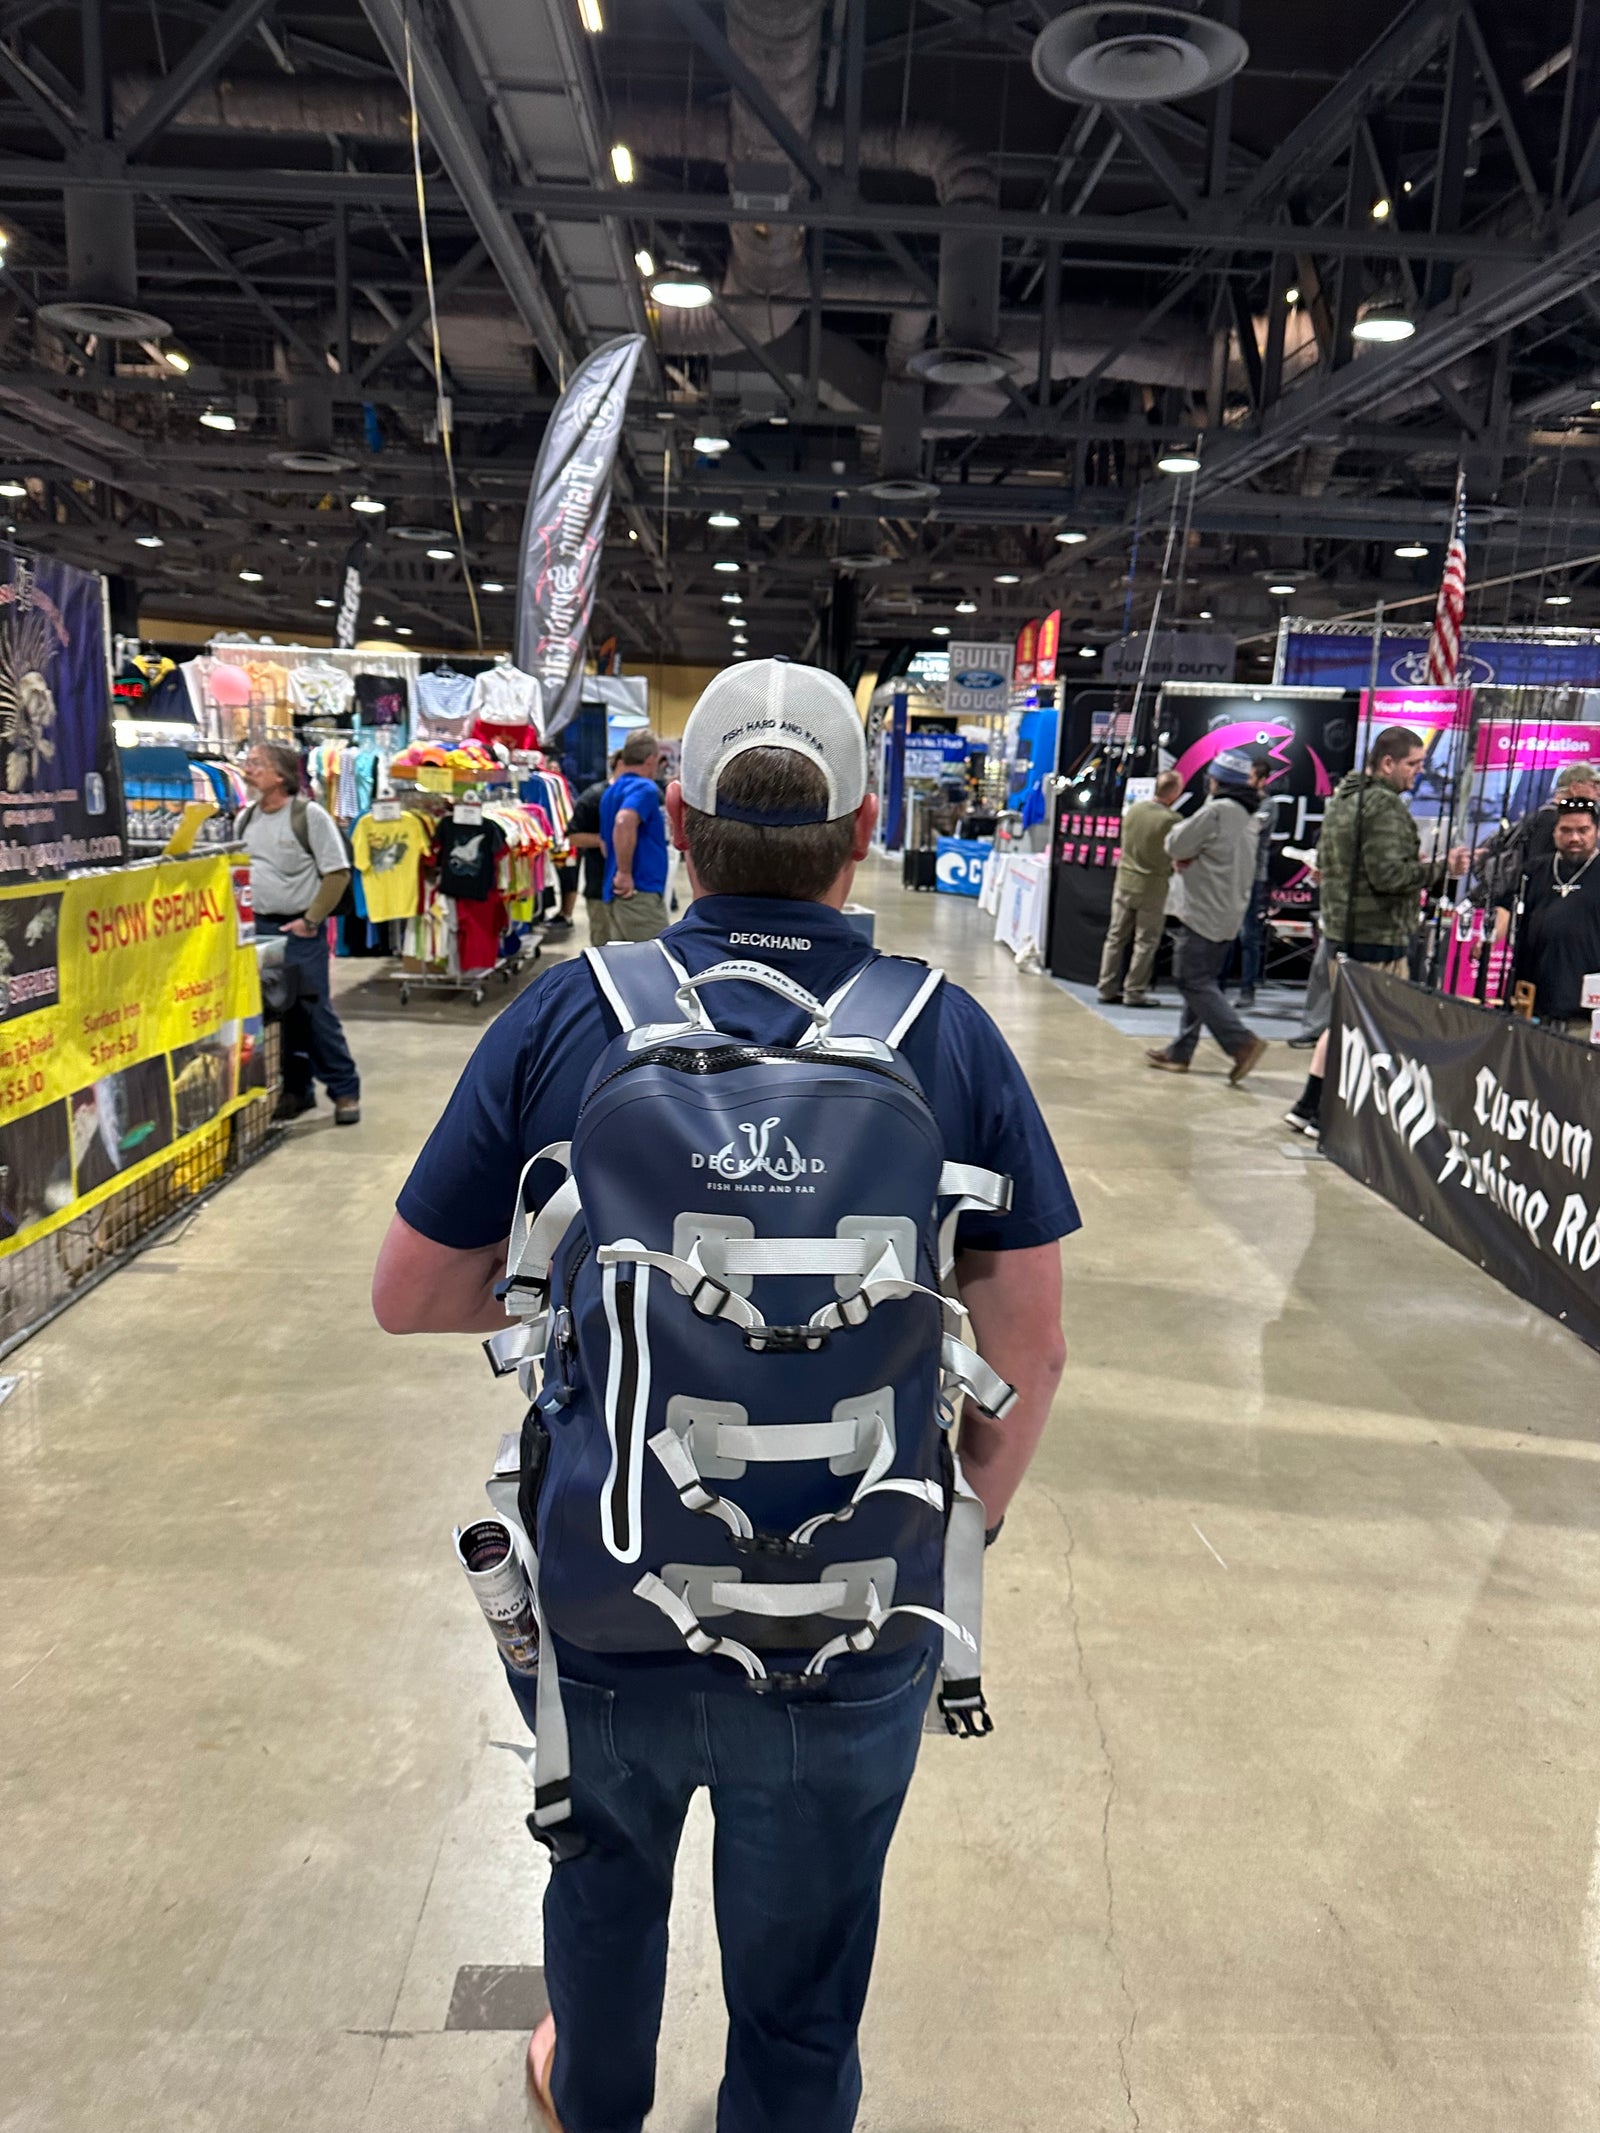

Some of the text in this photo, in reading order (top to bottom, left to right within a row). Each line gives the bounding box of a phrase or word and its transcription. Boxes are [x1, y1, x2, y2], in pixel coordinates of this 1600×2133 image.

[953, 649, 1008, 668] BUILT
[1177, 663, 1227, 674] DUTY
[951, 693, 1006, 709] TOUGH
[746, 719, 776, 732] HARD
[779, 721, 802, 735] AND
[86, 901, 147, 954] SHOW
[153, 888, 225, 938] SPECIAL
[729, 932, 812, 951] DECKHAND
[1473, 1065, 1593, 1181] Custom
[691, 1152, 825, 1175] DECKHAND
[706, 1182, 817, 1195] FISH HARD AND FAR
